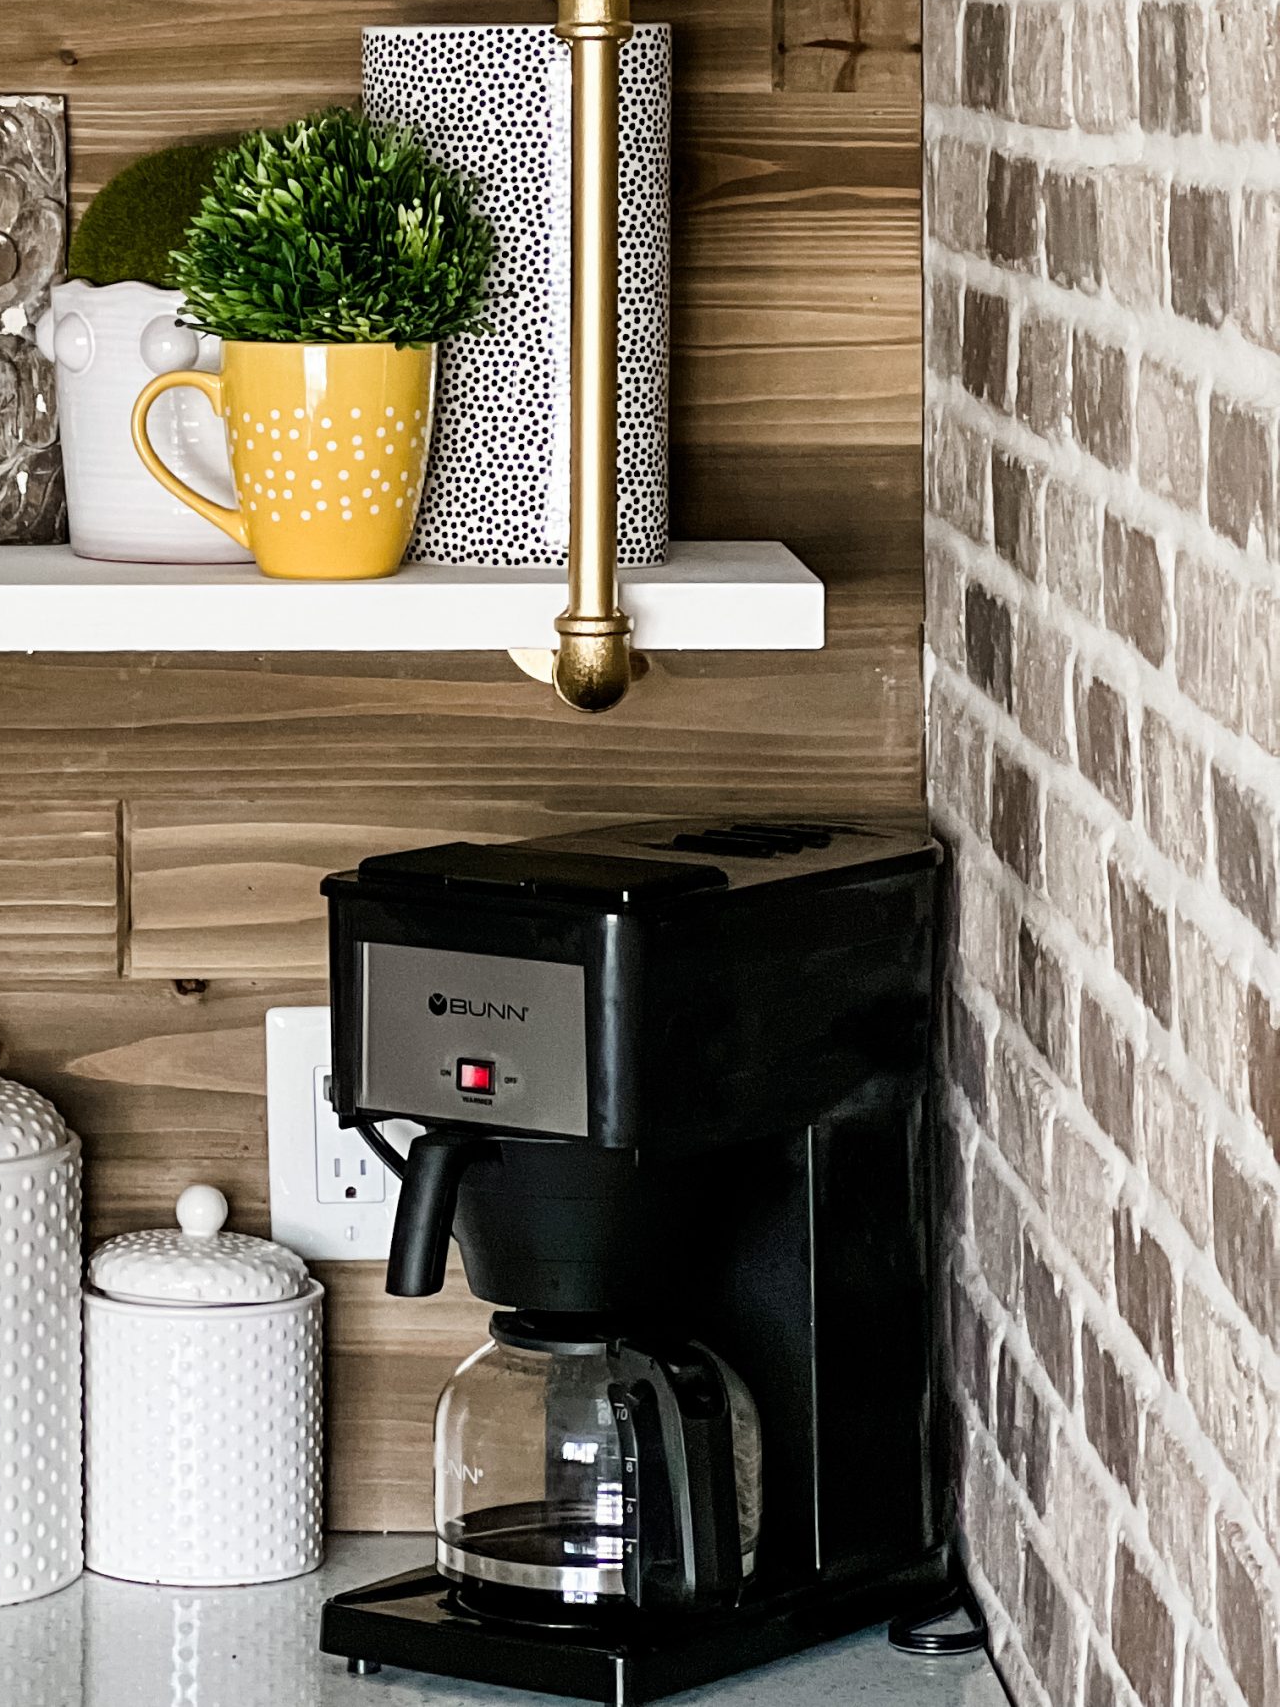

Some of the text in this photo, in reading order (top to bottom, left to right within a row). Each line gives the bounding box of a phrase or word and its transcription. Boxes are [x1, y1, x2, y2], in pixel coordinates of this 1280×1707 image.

[450, 998, 526, 1022] BUNN
[440, 1069, 452, 1077] ON
[615, 1408, 629, 1421] 10
[625, 1462, 634, 1473] 8
[626, 1503, 634, 1514] 6
[625, 1543, 633, 1554] 4
